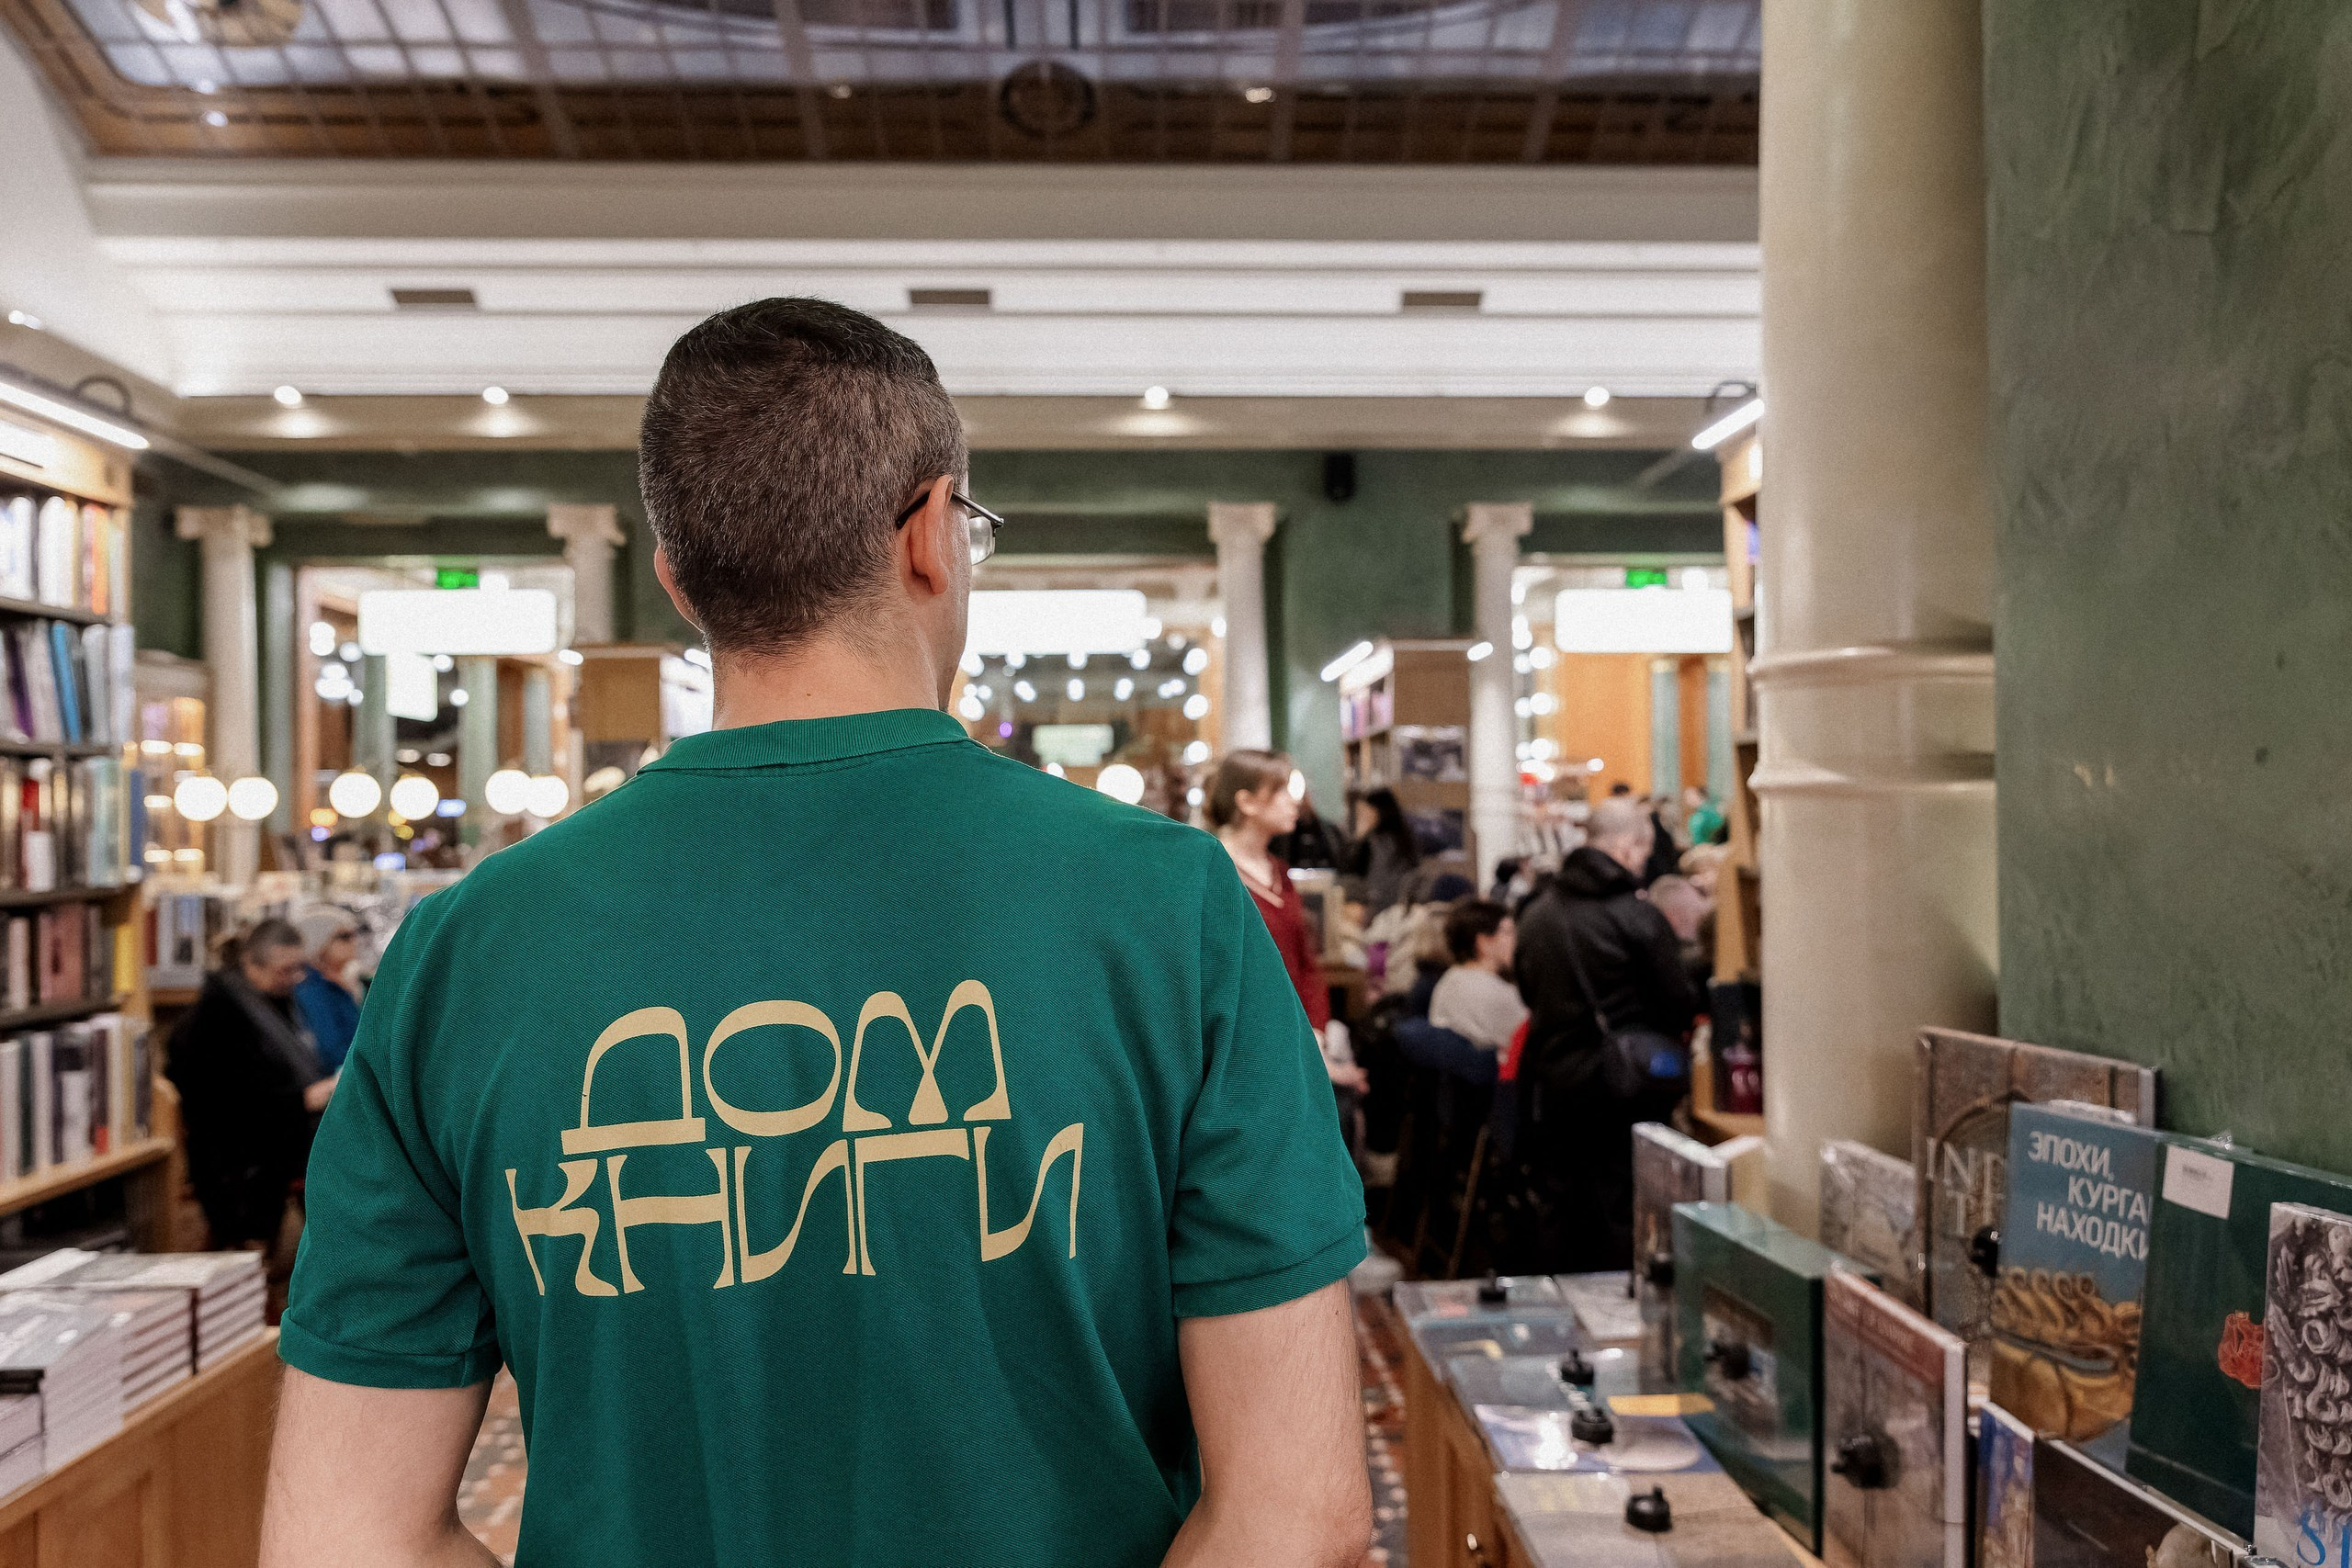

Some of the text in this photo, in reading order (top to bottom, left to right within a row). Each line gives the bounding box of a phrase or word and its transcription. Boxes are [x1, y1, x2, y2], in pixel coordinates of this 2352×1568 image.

[560, 979, 1012, 1155] ДОМ
[504, 1122, 1084, 1296] КНИГИ
[2068, 1175, 2153, 1226] КУРГА
